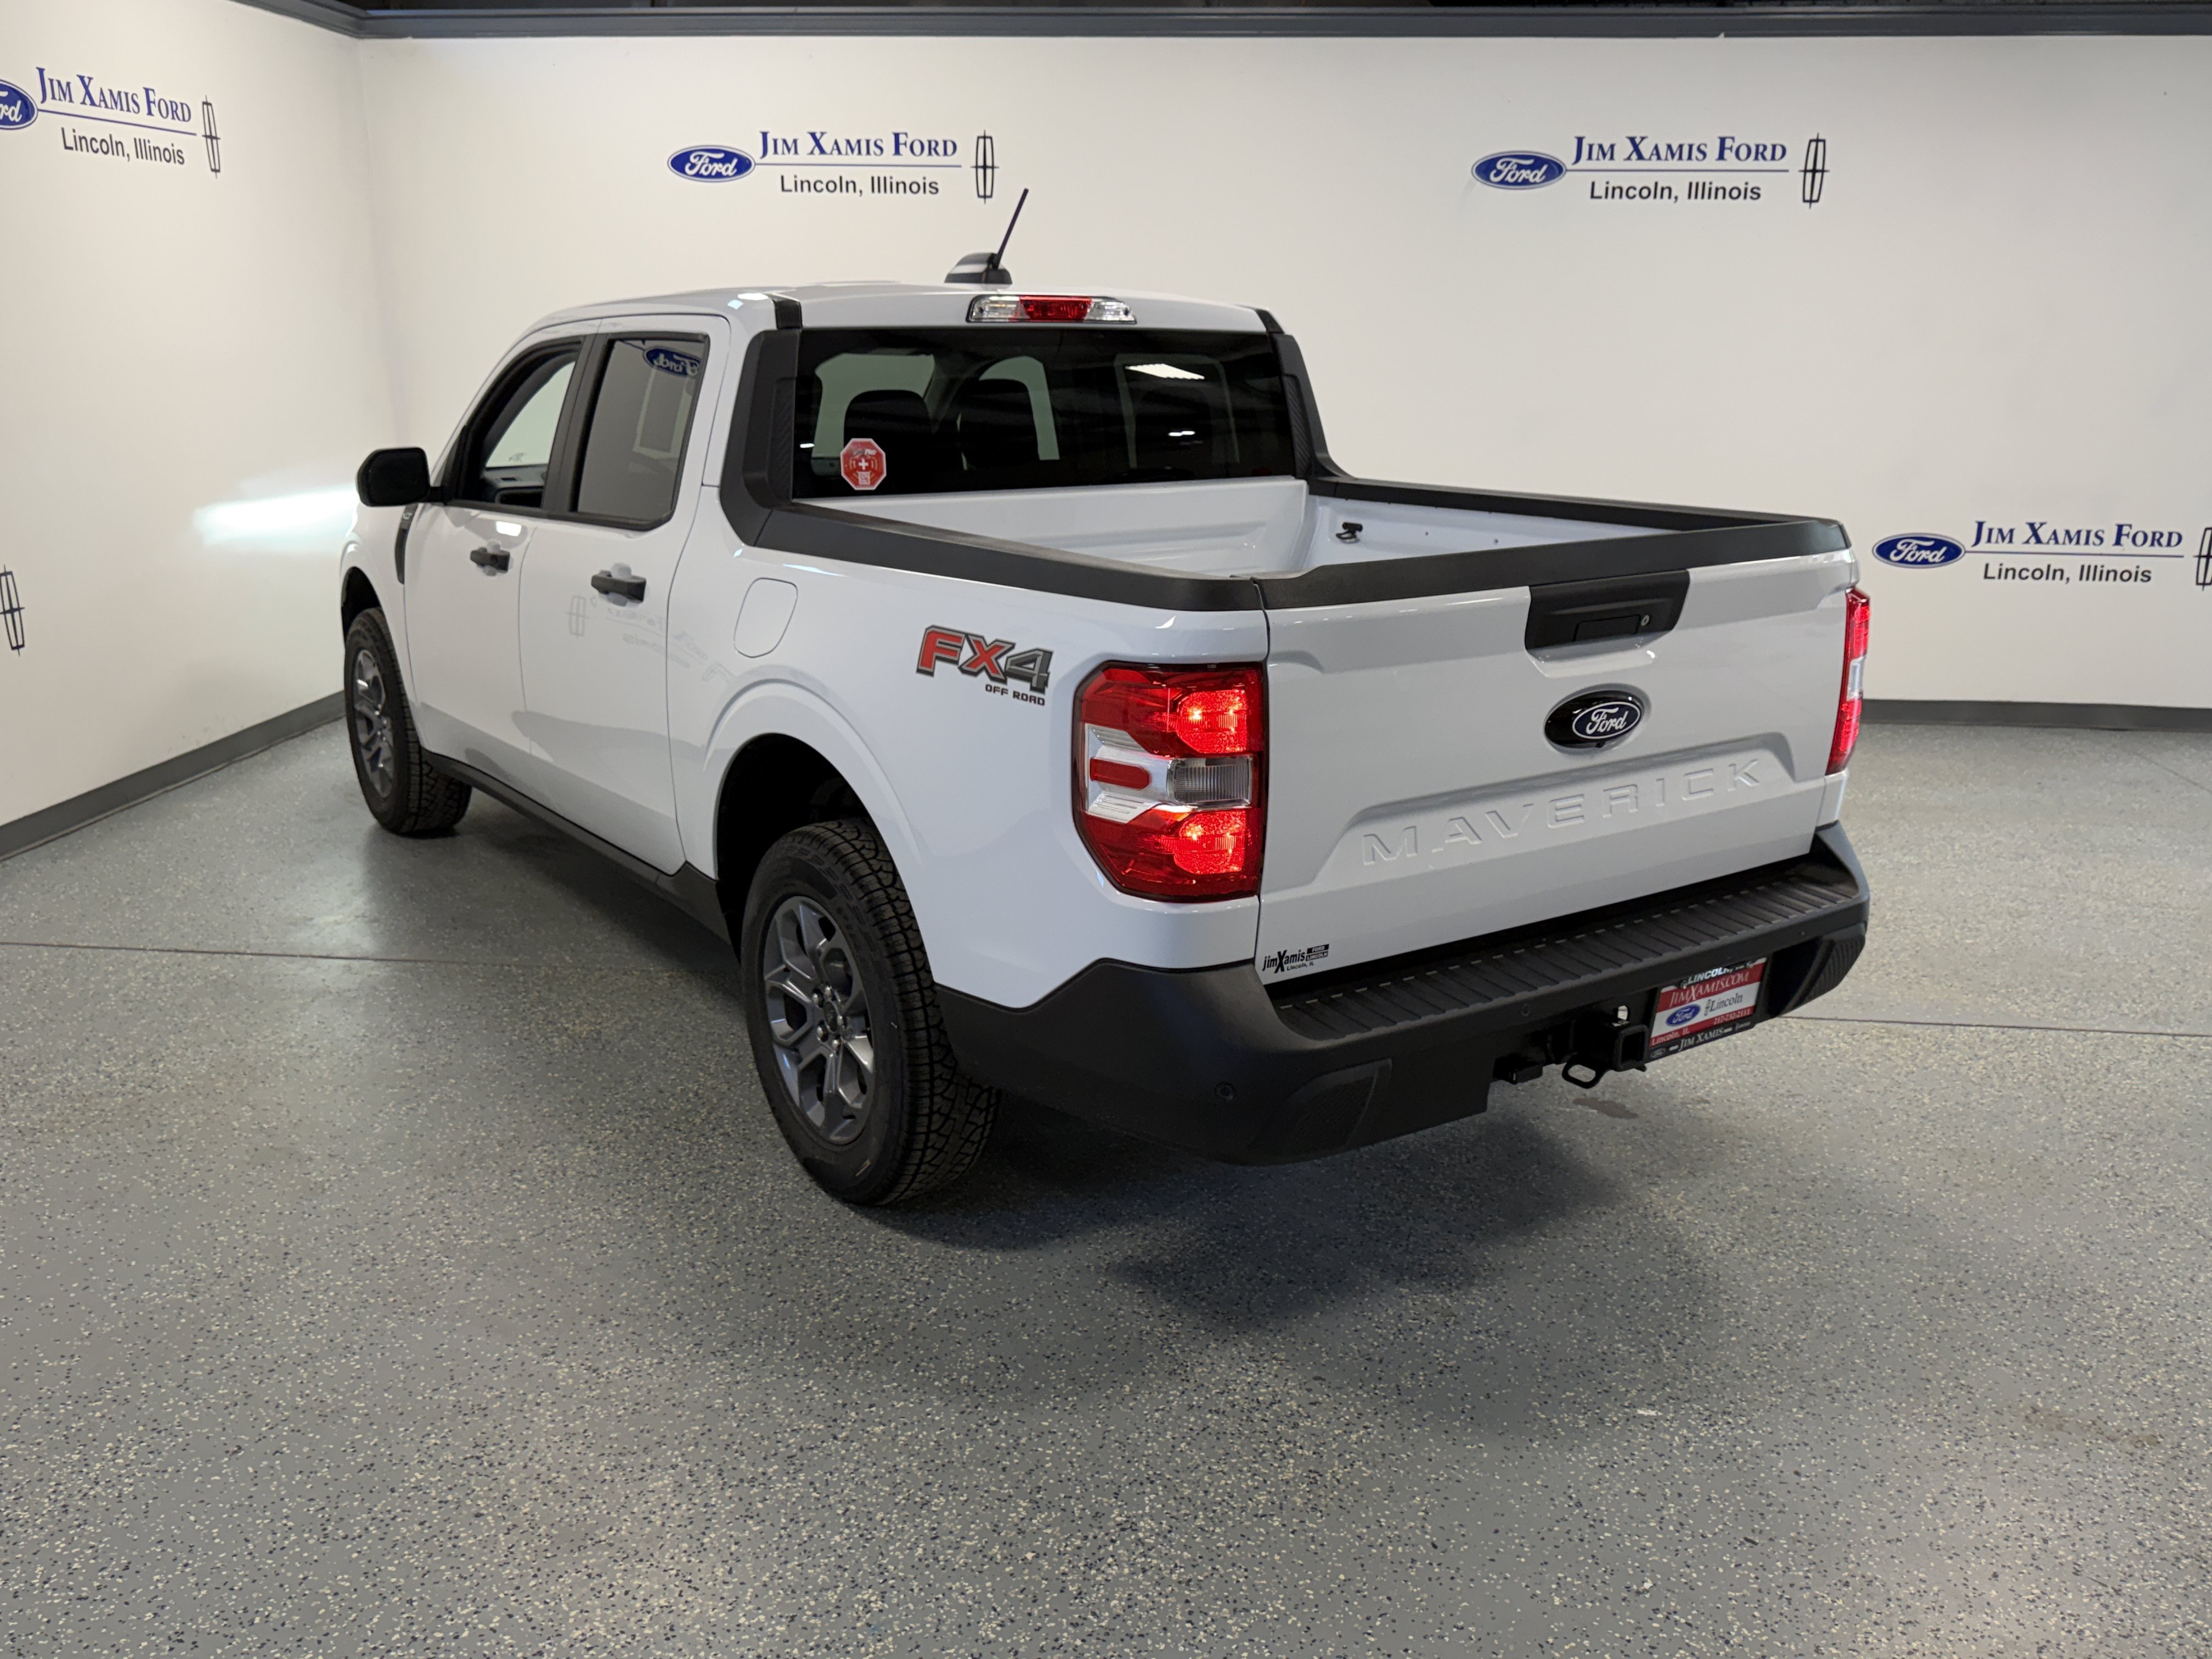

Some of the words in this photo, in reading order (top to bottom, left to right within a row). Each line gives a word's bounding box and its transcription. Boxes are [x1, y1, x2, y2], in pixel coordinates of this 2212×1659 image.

[35, 66, 75, 104] JIM
[77, 74, 140, 115] XAMIS
[143, 87, 191, 122] FORD
[61, 127, 131, 162] Lincoln,
[134, 137, 185, 165] Illinois
[759, 131, 798, 159] JIM
[806, 132, 884, 157] XAMIS
[891, 132, 957, 157] FORD
[1571, 136, 1616, 165] JIM
[1623, 136, 1707, 162] XAMIS
[1715, 137, 1787, 162] FORD
[685, 151, 738, 177] Ford
[1489, 157, 1548, 184] Ford
[780, 175, 863, 196] Lincoln,
[870, 176, 939, 195] Illinois
[1590, 181, 1678, 203] Lincoln,
[1687, 182, 1762, 201] Illinois
[1971, 521, 2014, 548] JIM
[2022, 522, 2104, 547] XAMIS
[2112, 523, 2183, 548] FORD
[1889, 538, 1947, 563] Ford
[1983, 563, 2070, 584] Lincoln,
[2079, 565, 2151, 583] Illinois
[916, 624, 1054, 695] FX4
[985, 684, 1009, 696] OFF
[1012, 690, 1045, 706] ROAD
[1585, 707, 1629, 735] Ford
[1362, 758, 1761, 867] MAVERICK
[1709, 993, 1743, 1012] Lincoln
[1673, 1008, 1695, 1024] Ford
[1678, 1036, 1695, 1051] JIM
[1696, 1027, 1724, 1043] XAMIS
